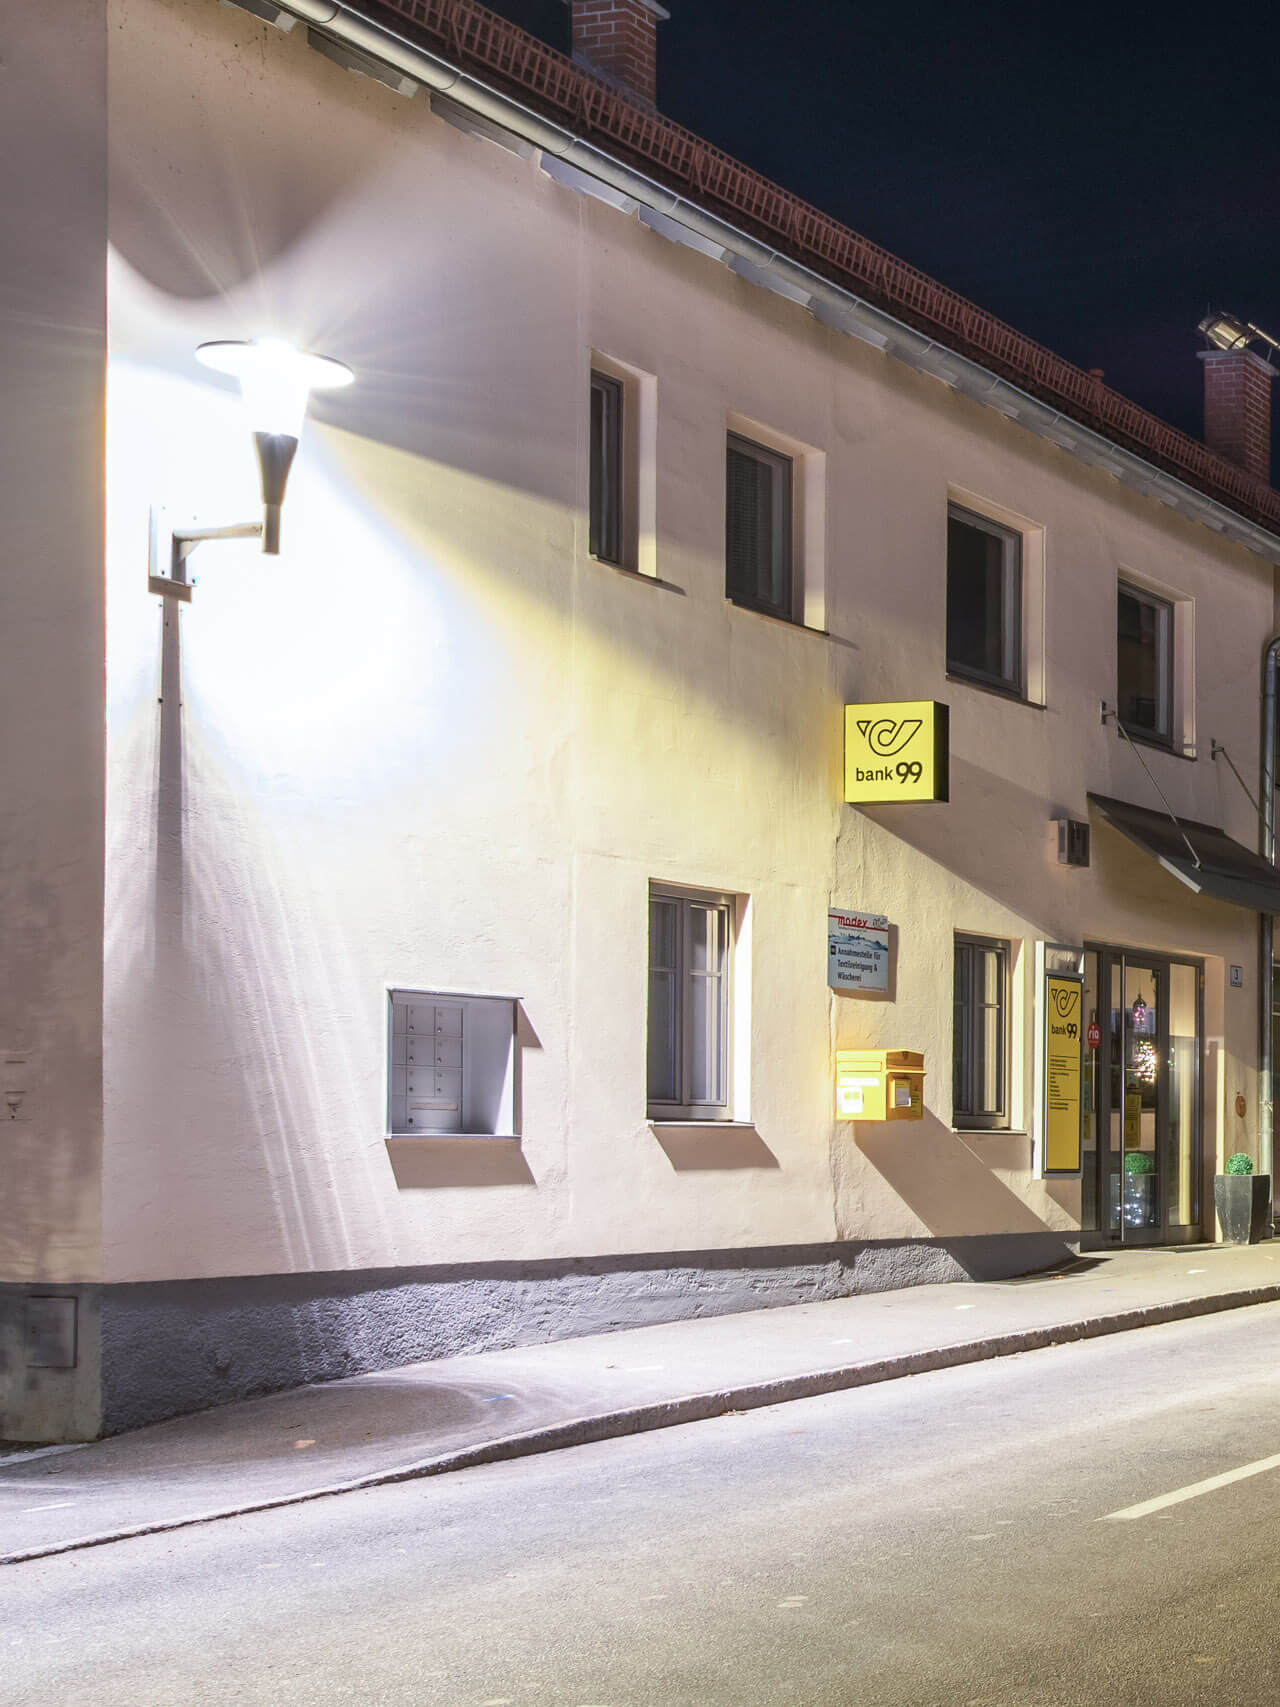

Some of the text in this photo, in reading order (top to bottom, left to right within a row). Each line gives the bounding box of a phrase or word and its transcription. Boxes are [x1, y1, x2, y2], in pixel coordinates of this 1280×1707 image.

[856, 761, 923, 784] bank 99
[1052, 1023, 1077, 1038] bank 99
[1088, 1024, 1099, 1039] ria
